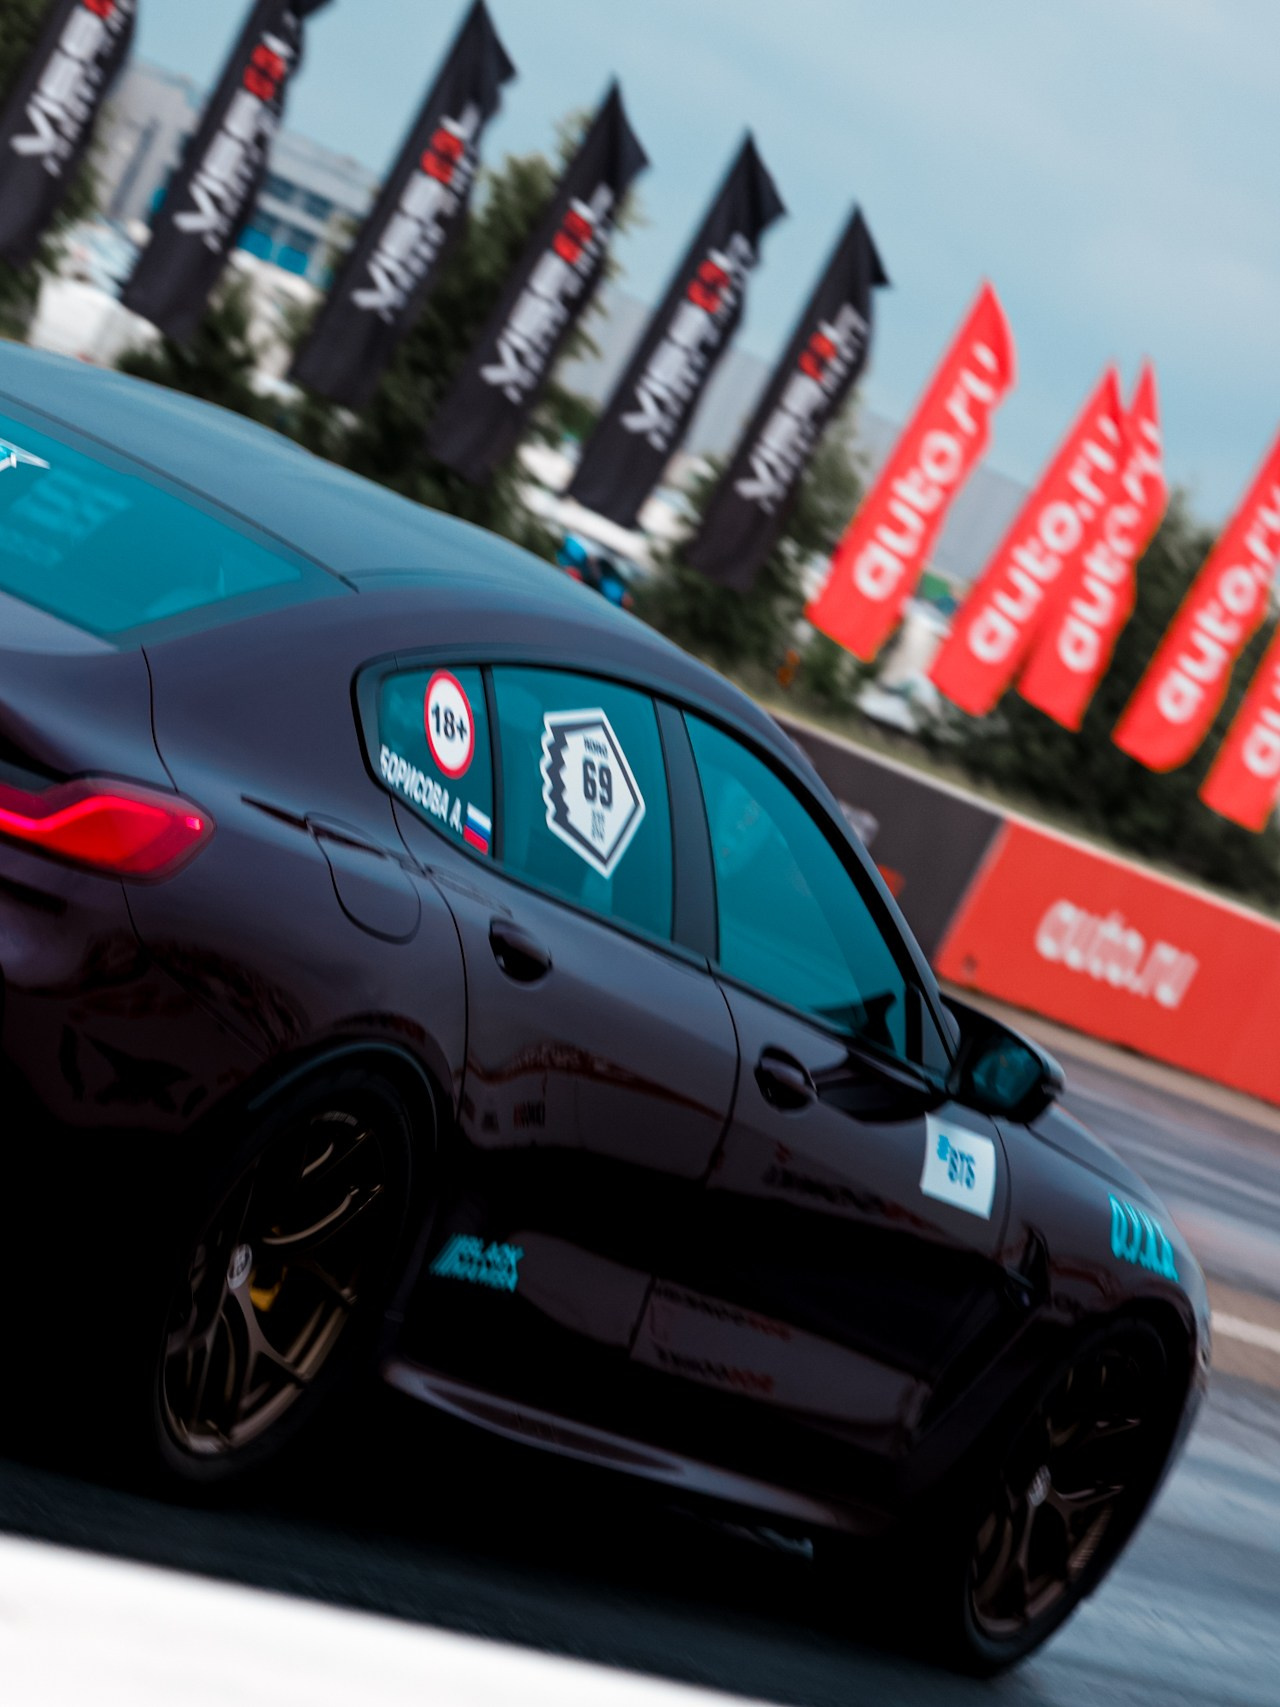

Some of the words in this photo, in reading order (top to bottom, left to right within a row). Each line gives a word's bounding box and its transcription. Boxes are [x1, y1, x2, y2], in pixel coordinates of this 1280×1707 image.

[967, 415, 1119, 664] auto.ru
[431, 703, 468, 742] 18+
[379, 743, 450, 823] БОРИСОВА
[582, 757, 613, 811] 69
[1035, 899, 1199, 1010] auto.ru
